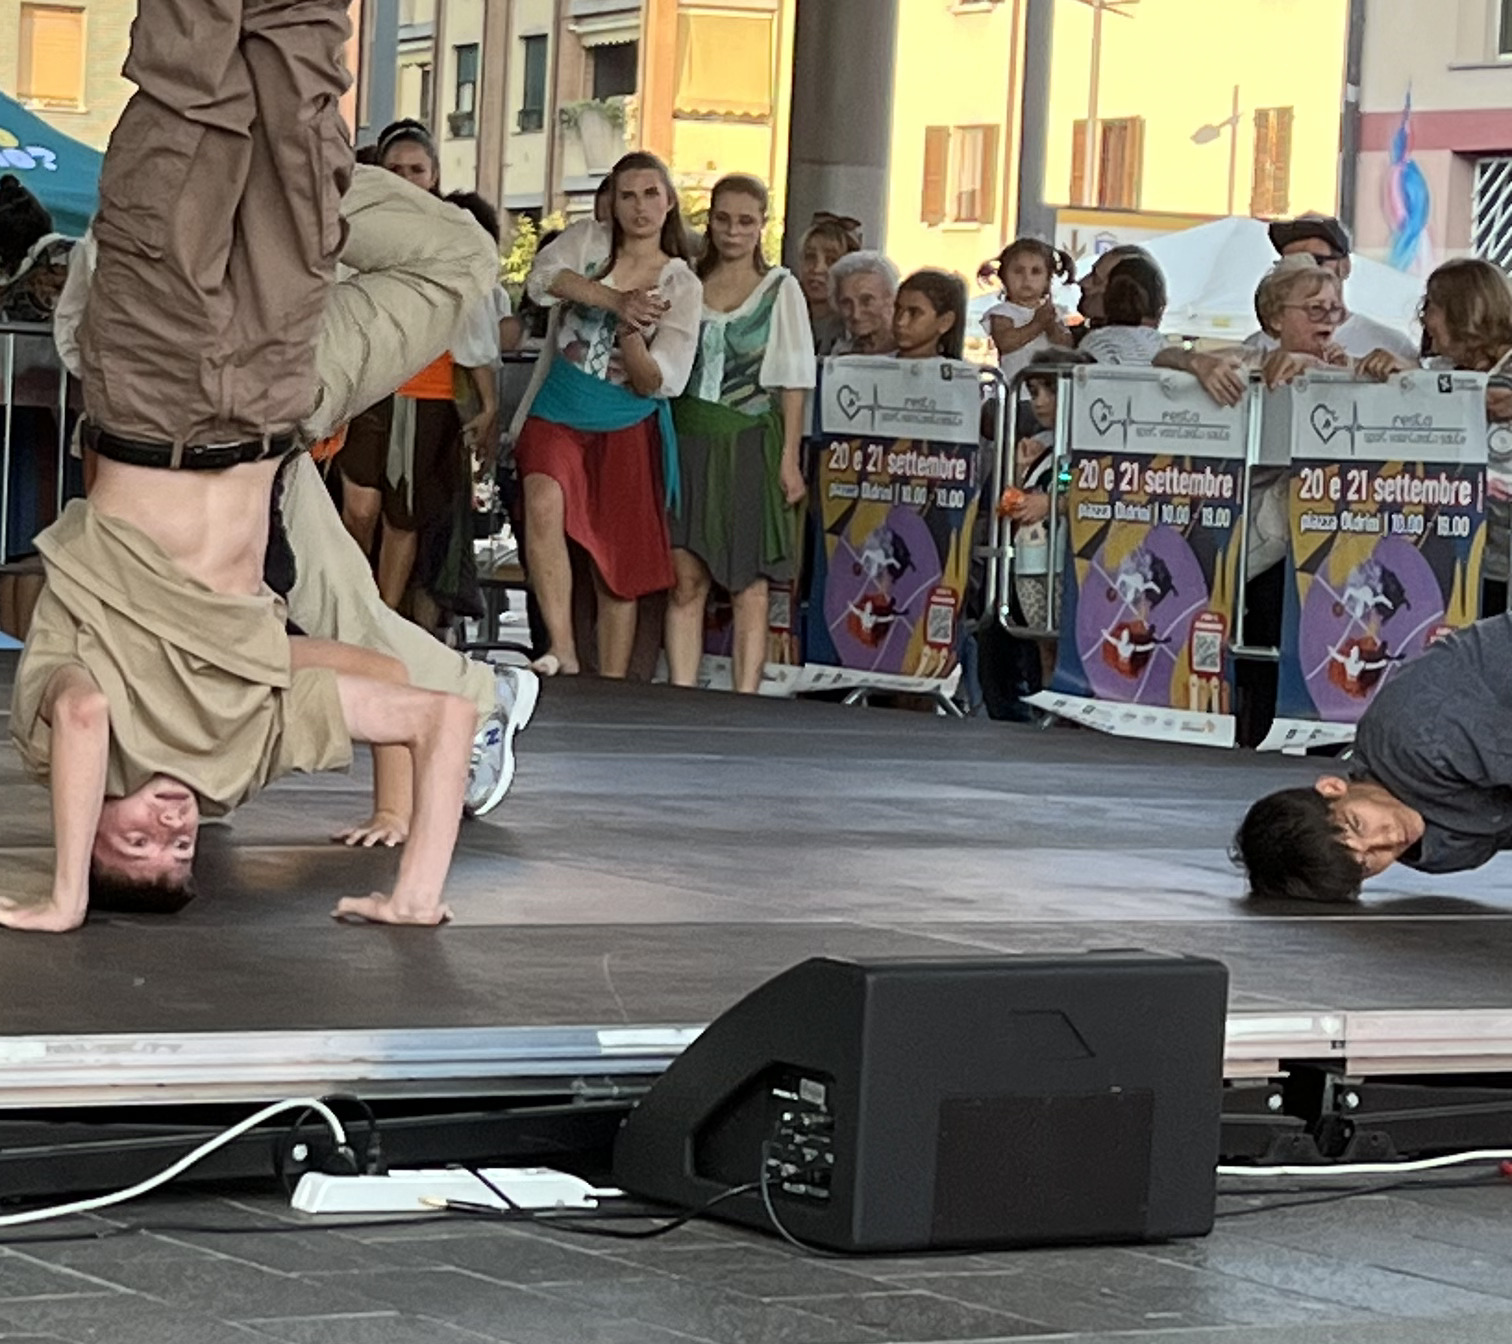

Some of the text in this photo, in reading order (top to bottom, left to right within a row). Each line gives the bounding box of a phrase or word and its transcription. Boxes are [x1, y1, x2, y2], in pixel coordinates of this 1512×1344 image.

[829, 442, 966, 480] 20 e 21 settembre
[1079, 459, 1232, 498] 20 e 21 settembre
[1300, 468, 1471, 505] 20 e 21 settembre
